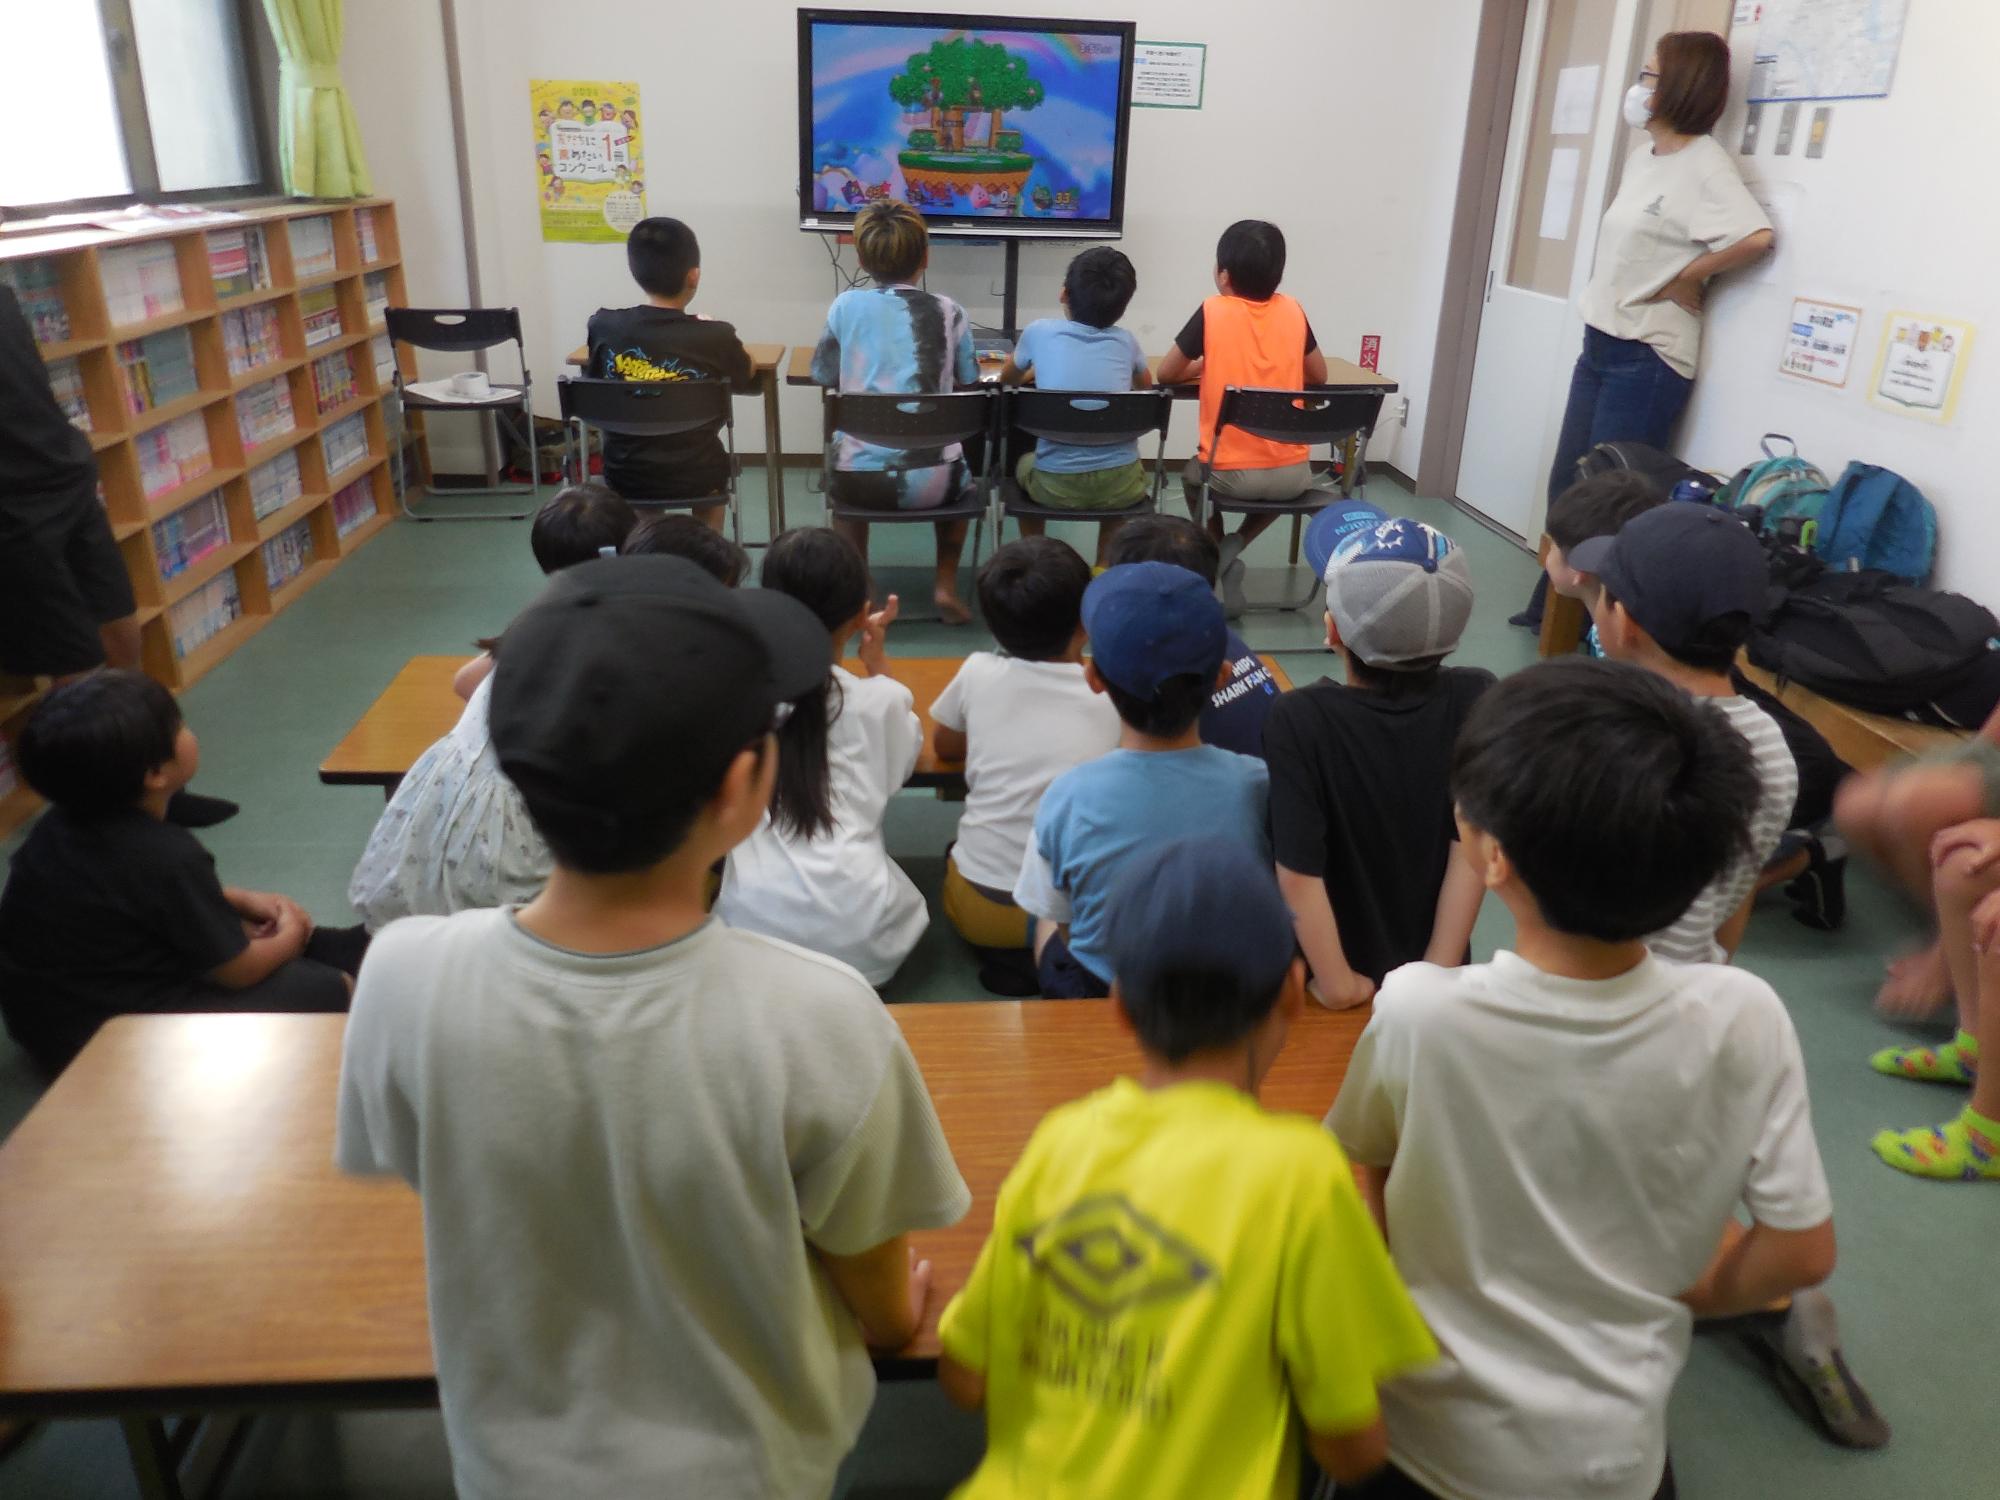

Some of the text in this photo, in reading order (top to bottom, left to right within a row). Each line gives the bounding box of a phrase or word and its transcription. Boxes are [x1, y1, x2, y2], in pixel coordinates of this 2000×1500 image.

[559, 162, 608, 174] コンクール
[1211, 680, 1249, 708] SHARK
